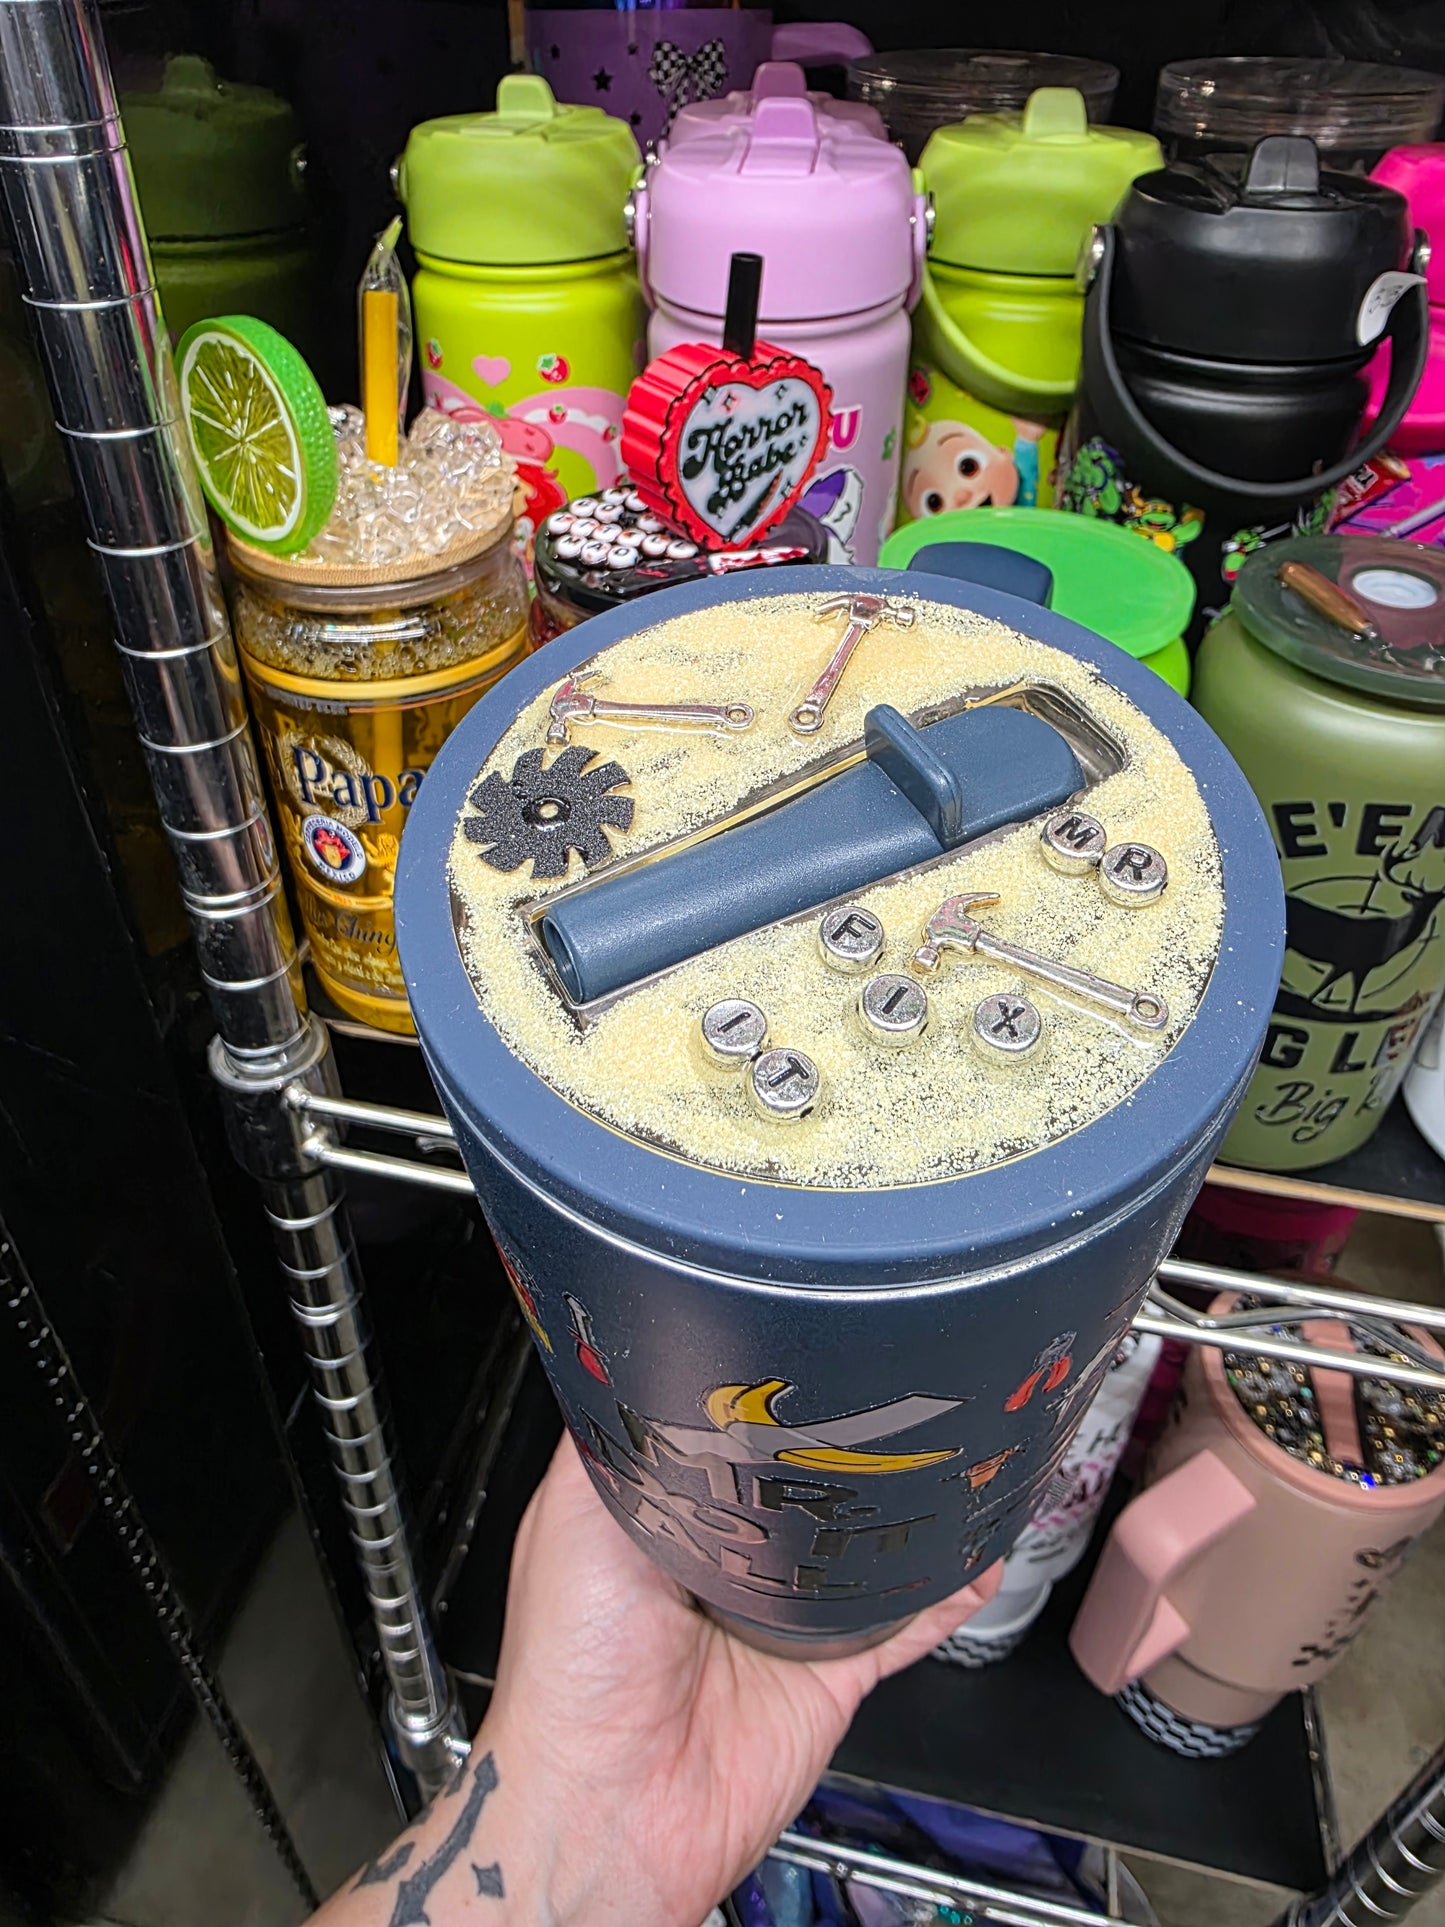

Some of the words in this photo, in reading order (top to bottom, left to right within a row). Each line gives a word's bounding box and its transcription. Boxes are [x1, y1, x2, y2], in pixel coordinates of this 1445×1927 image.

[683, 402, 808, 479] Horror
[707, 442, 798, 514] Babe
[291, 744, 426, 824] Papa
[1254, 1079, 1351, 1144] Big
